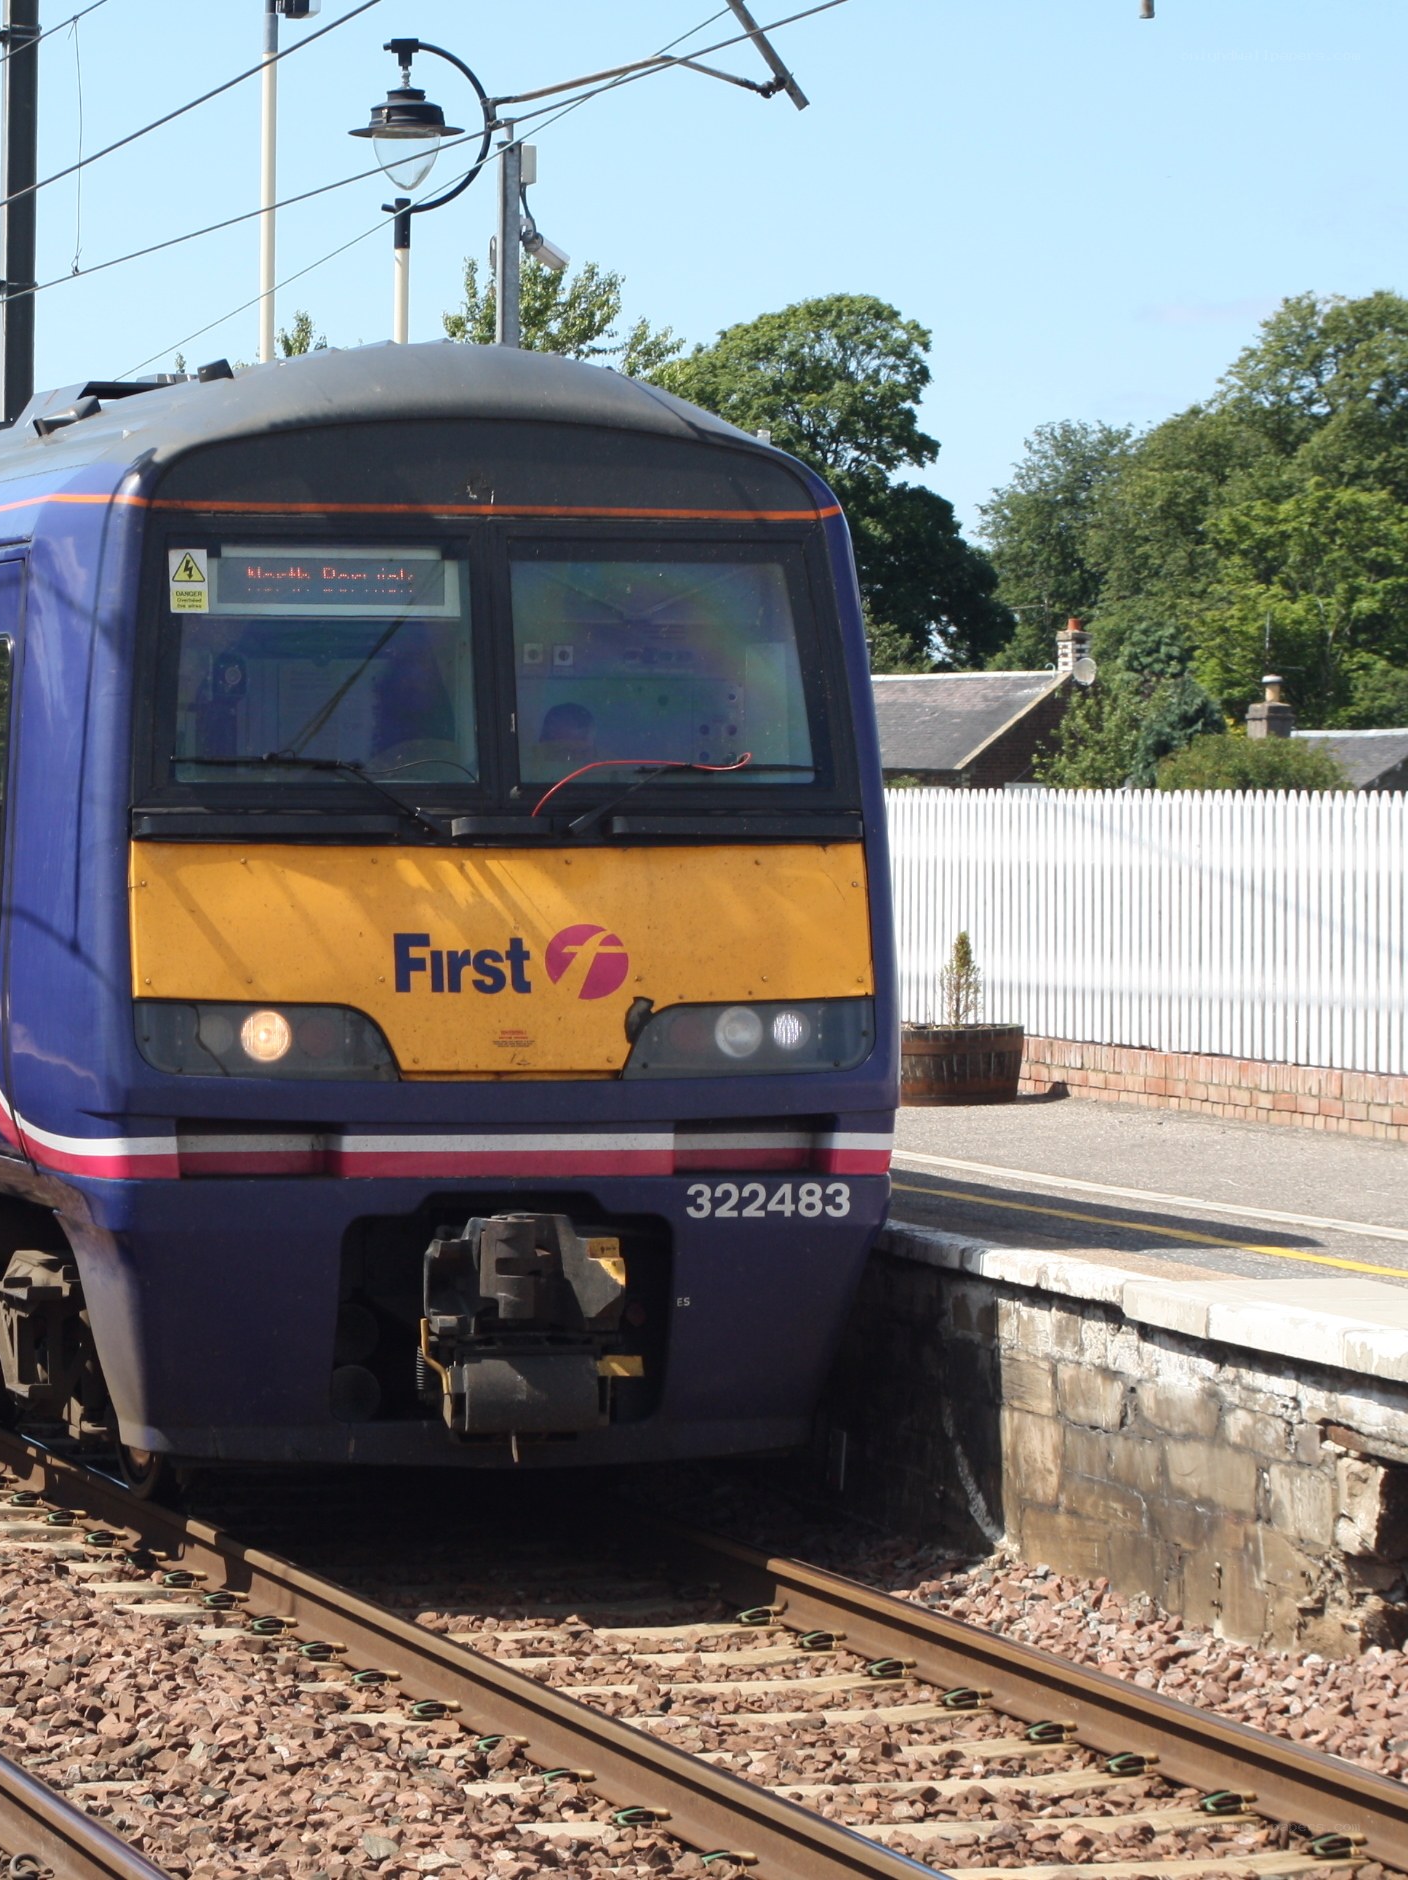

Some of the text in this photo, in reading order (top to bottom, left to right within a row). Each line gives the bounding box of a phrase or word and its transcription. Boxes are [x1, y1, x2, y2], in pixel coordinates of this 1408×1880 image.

[393, 932, 532, 995] First
[686, 1182, 852, 1219] 322483
[676, 1296, 691, 1307] ES
